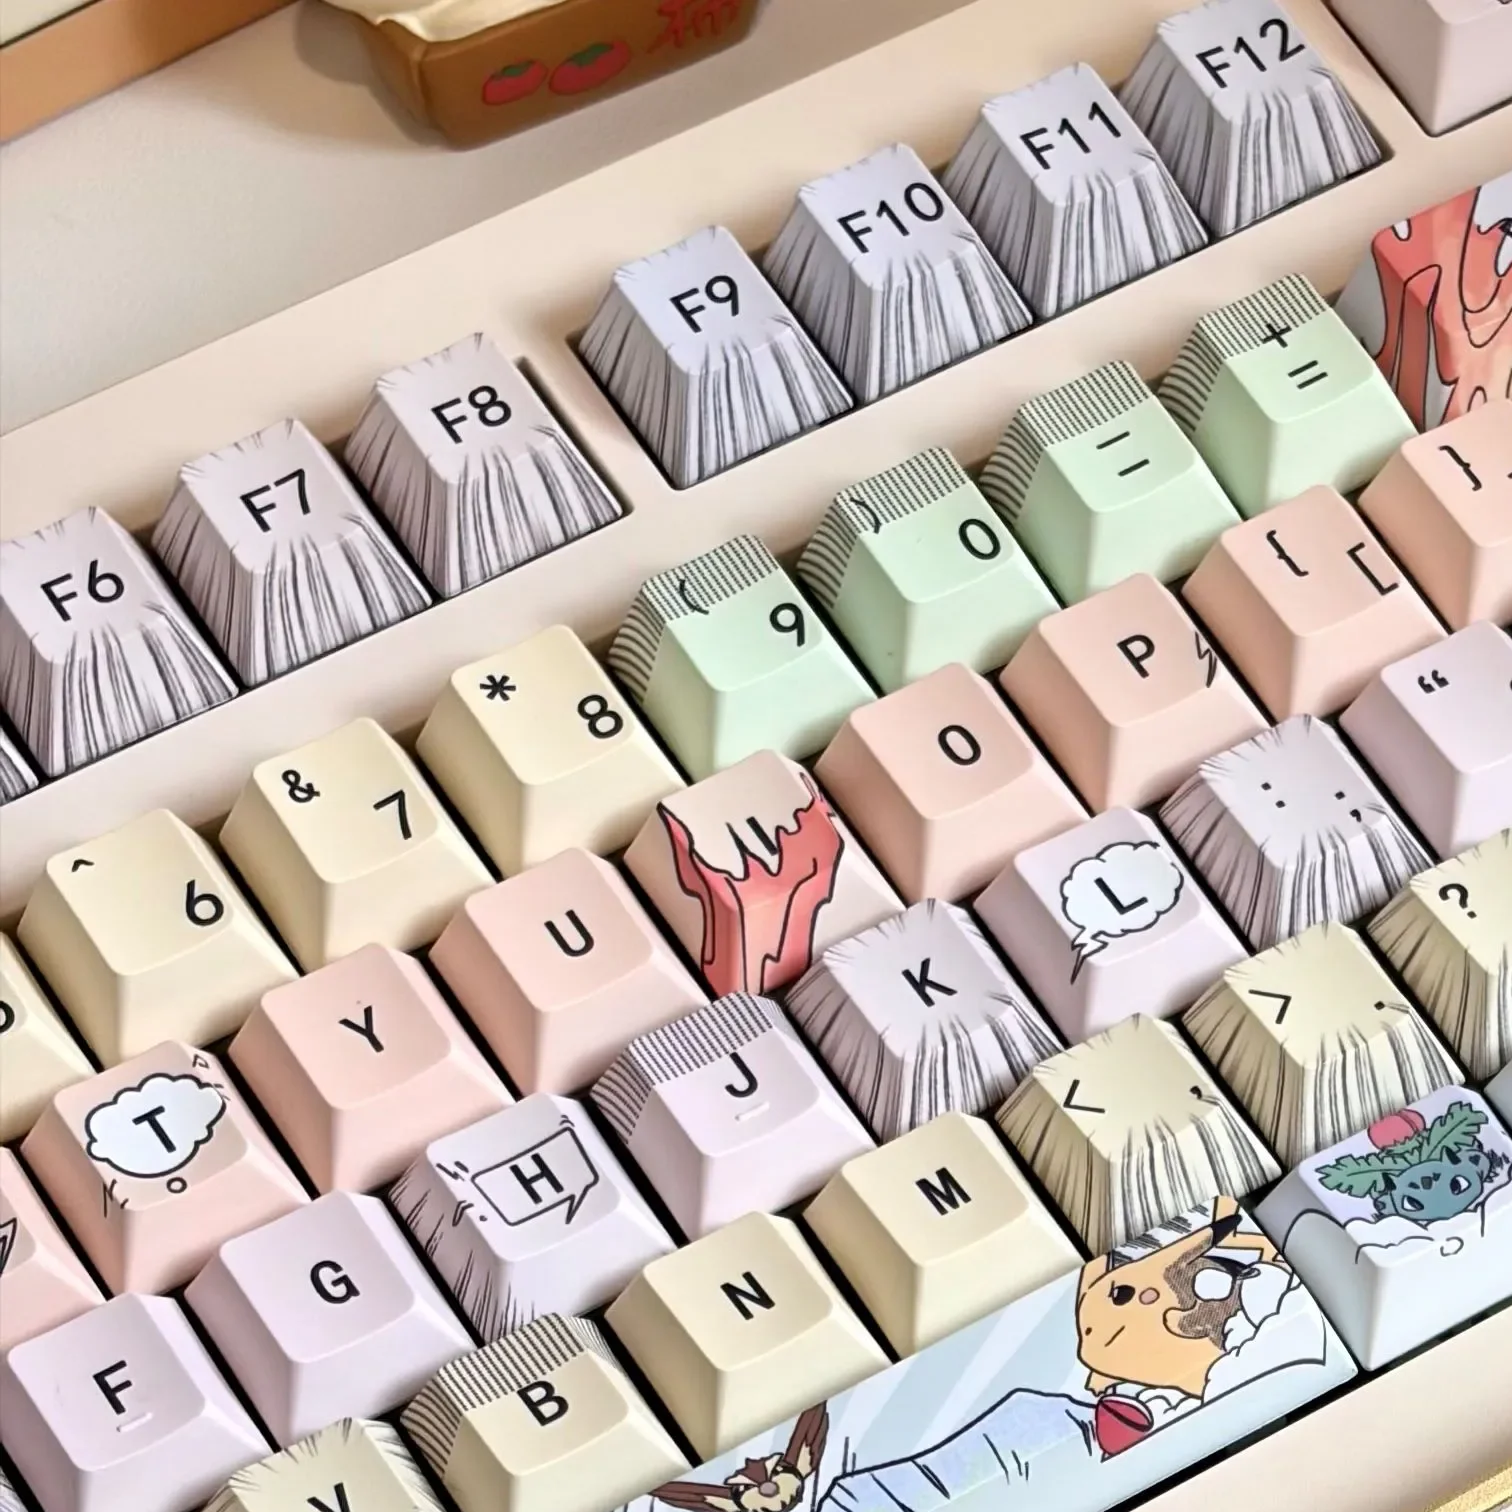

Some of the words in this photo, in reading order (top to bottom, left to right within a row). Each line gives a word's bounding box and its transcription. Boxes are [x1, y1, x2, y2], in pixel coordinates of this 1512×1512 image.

[1195, 18, 1306, 89] F12
[1020, 101, 1122, 170] F11
[837, 182, 944, 254] F10
[669, 275, 739, 333] F9
[431, 385, 512, 444] F8
[239, 468, 311, 533] F7
[40, 559, 125, 622] F6
[769, 602, 805, 647] 9
[1117, 634, 1155, 678] P
[577, 694, 624, 739] 8
[937, 724, 981, 766] O
[373, 789, 412, 840] 7
[185, 879, 224, 927] 6
[1094, 877, 1148, 915] L
[544, 909, 594, 957] U
[901, 957, 957, 1007] K
[339, 1005, 384, 1053] Y
[725, 1051, 758, 1098] J
[132, 1105, 176, 1153] T
[509, 1153, 564, 1205] H
[915, 1167, 972, 1216] M
[310, 1260, 360, 1304] G
[720, 1271, 775, 1321] N
[92, 1360, 133, 1415] F
[516, 1380, 569, 1427] B
